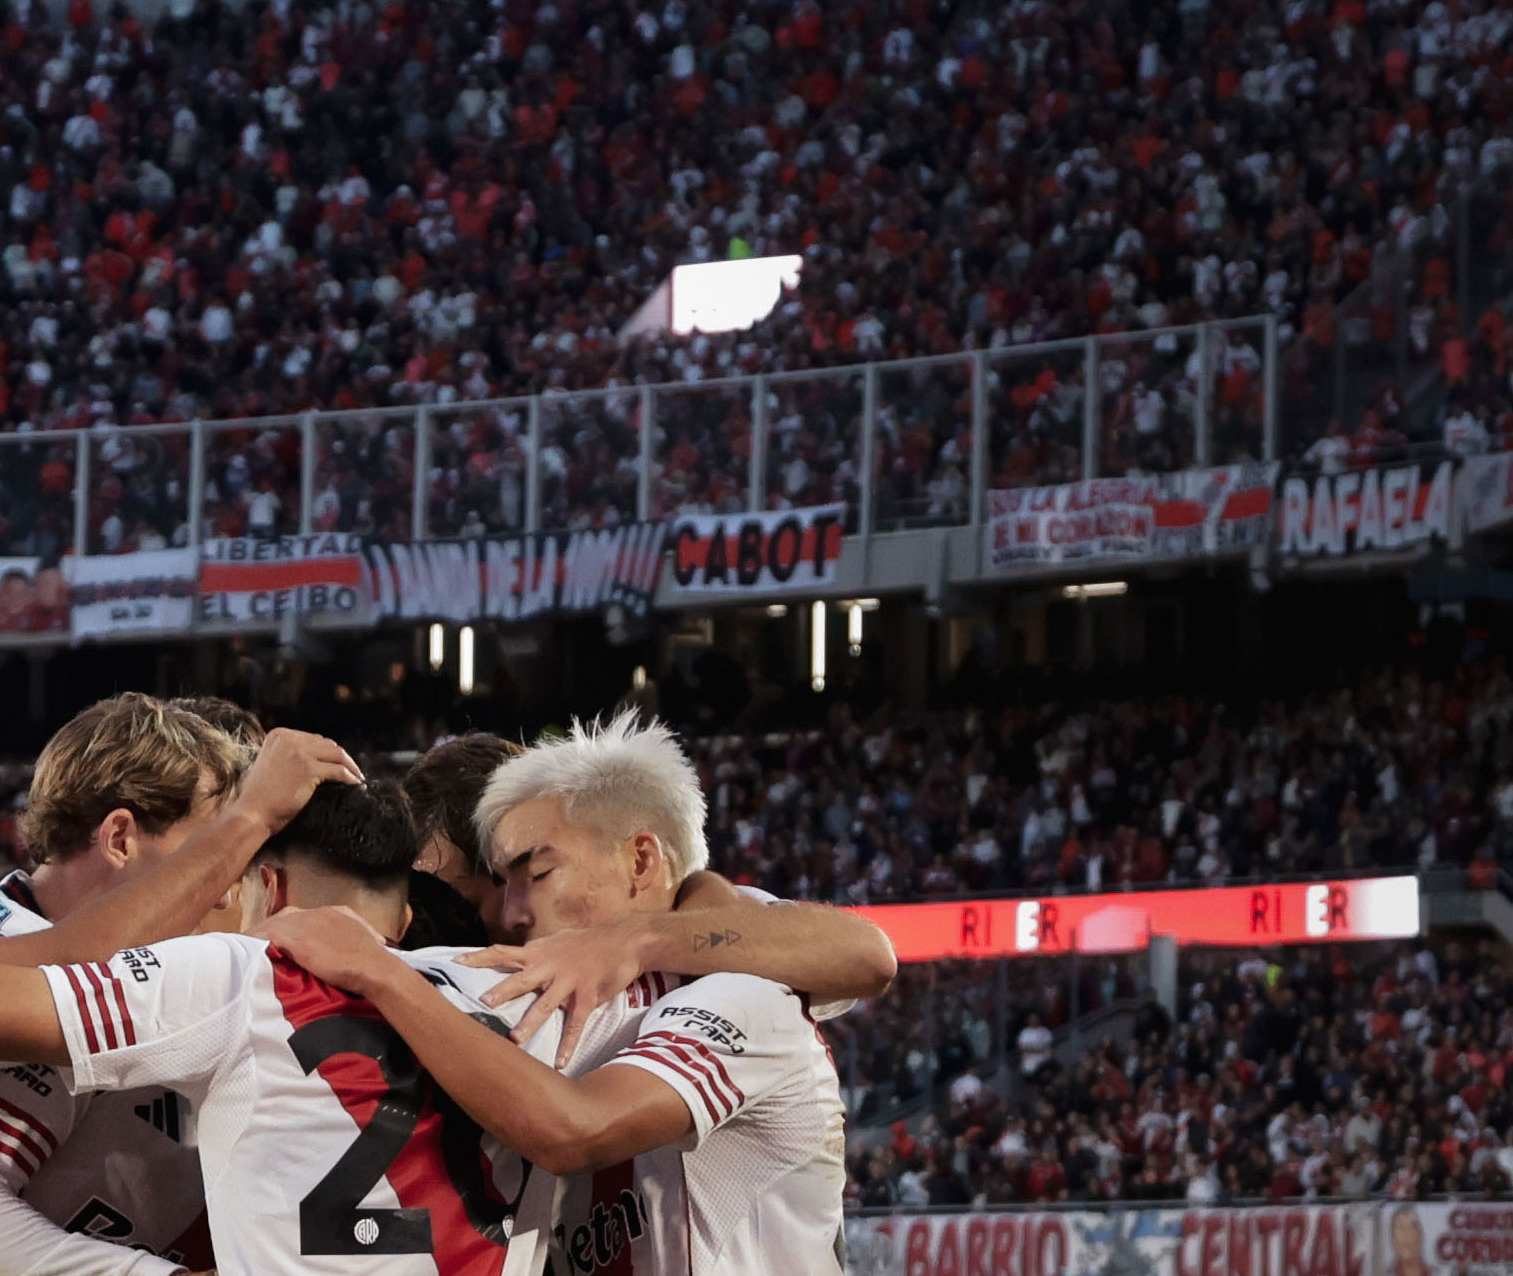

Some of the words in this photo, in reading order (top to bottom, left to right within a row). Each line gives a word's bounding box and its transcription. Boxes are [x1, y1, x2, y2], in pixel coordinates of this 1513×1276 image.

[1281, 460, 1455, 556] RAFAELA
[675, 516, 837, 586] CABOT
[250, 586, 356, 618] CEIBO
[659, 1007, 747, 1040] ASSIST
